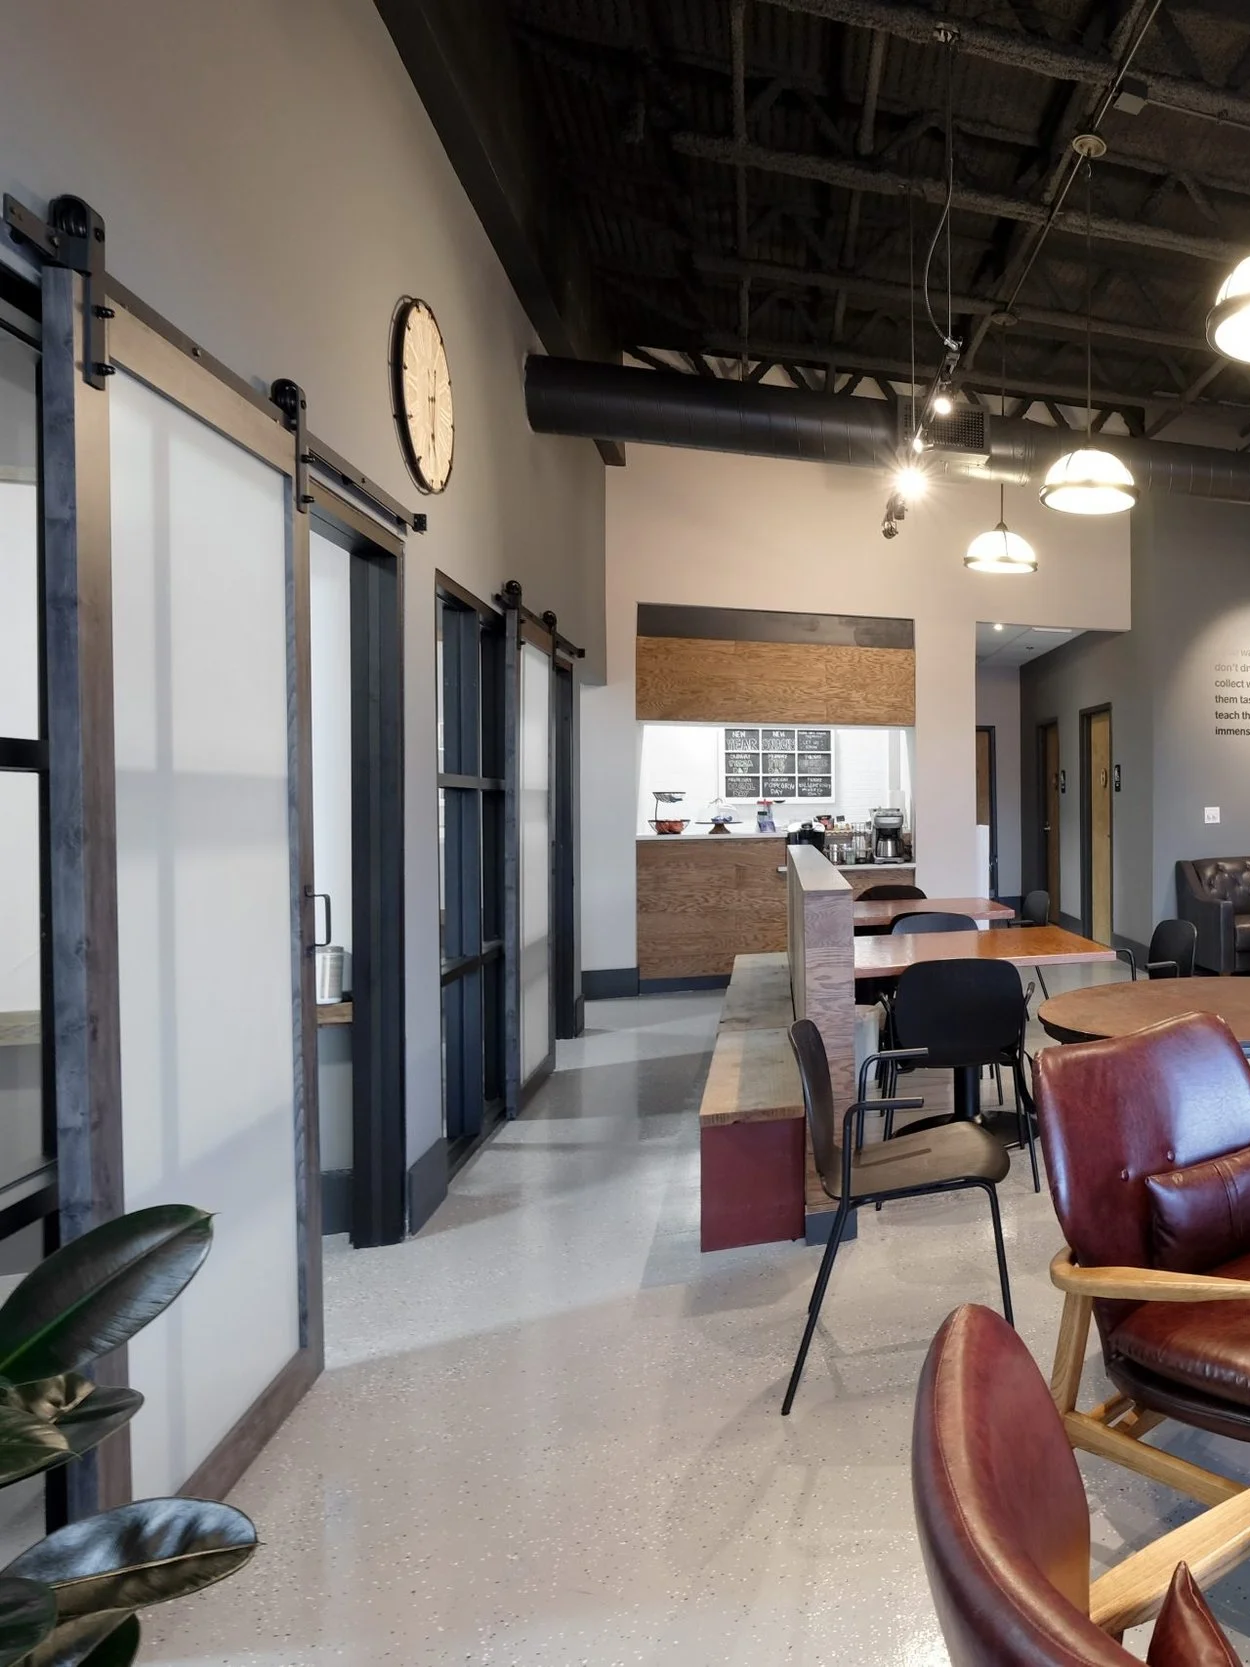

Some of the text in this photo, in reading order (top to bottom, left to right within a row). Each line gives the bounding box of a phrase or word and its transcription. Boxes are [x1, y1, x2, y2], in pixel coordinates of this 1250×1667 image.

[1214, 664, 1239, 672] don't
[1214, 680, 1244, 688] collect
[1214, 695, 1238, 704] them
[1214, 710, 1240, 720] teach
[732, 730, 746, 738] NEW
